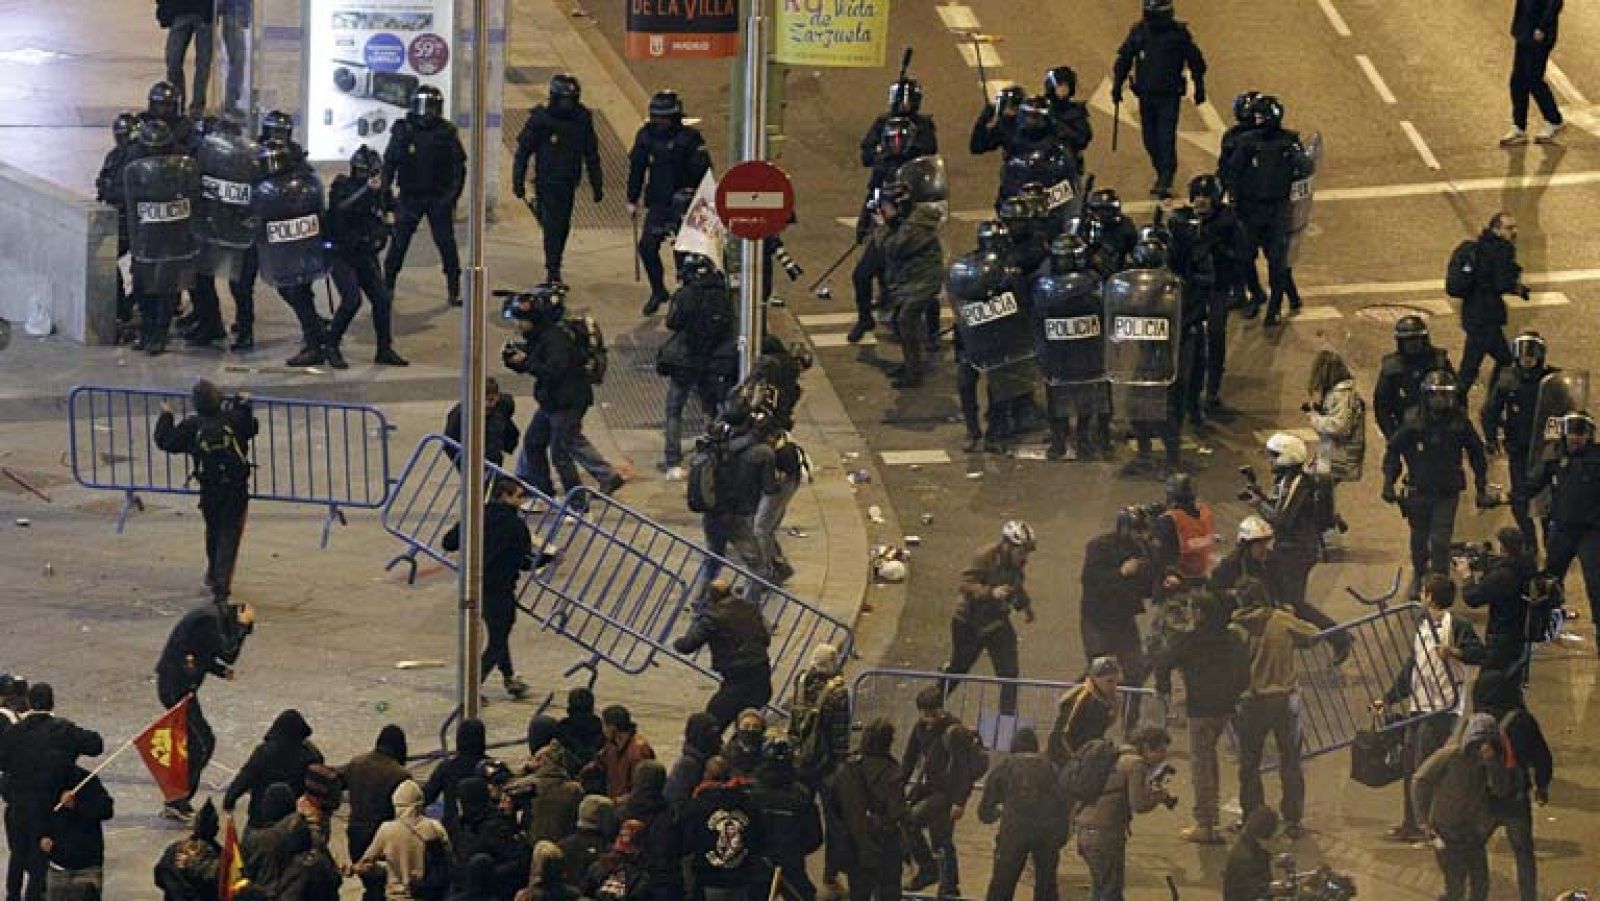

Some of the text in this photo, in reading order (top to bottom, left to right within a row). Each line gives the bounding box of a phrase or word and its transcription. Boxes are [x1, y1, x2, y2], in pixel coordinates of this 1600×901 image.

[632, 0, 734, 19] DE LA VILLA
[810, 14, 832, 26] de
[790, 21, 872, 48] Zarzuela
[139, 199, 190, 222] POLICIA
[267, 216, 319, 241] POLICIA
[962, 293, 1017, 325] POLICIA
[1046, 316, 1100, 339] POLICIA
[1115, 318, 1168, 339] POLICIA
